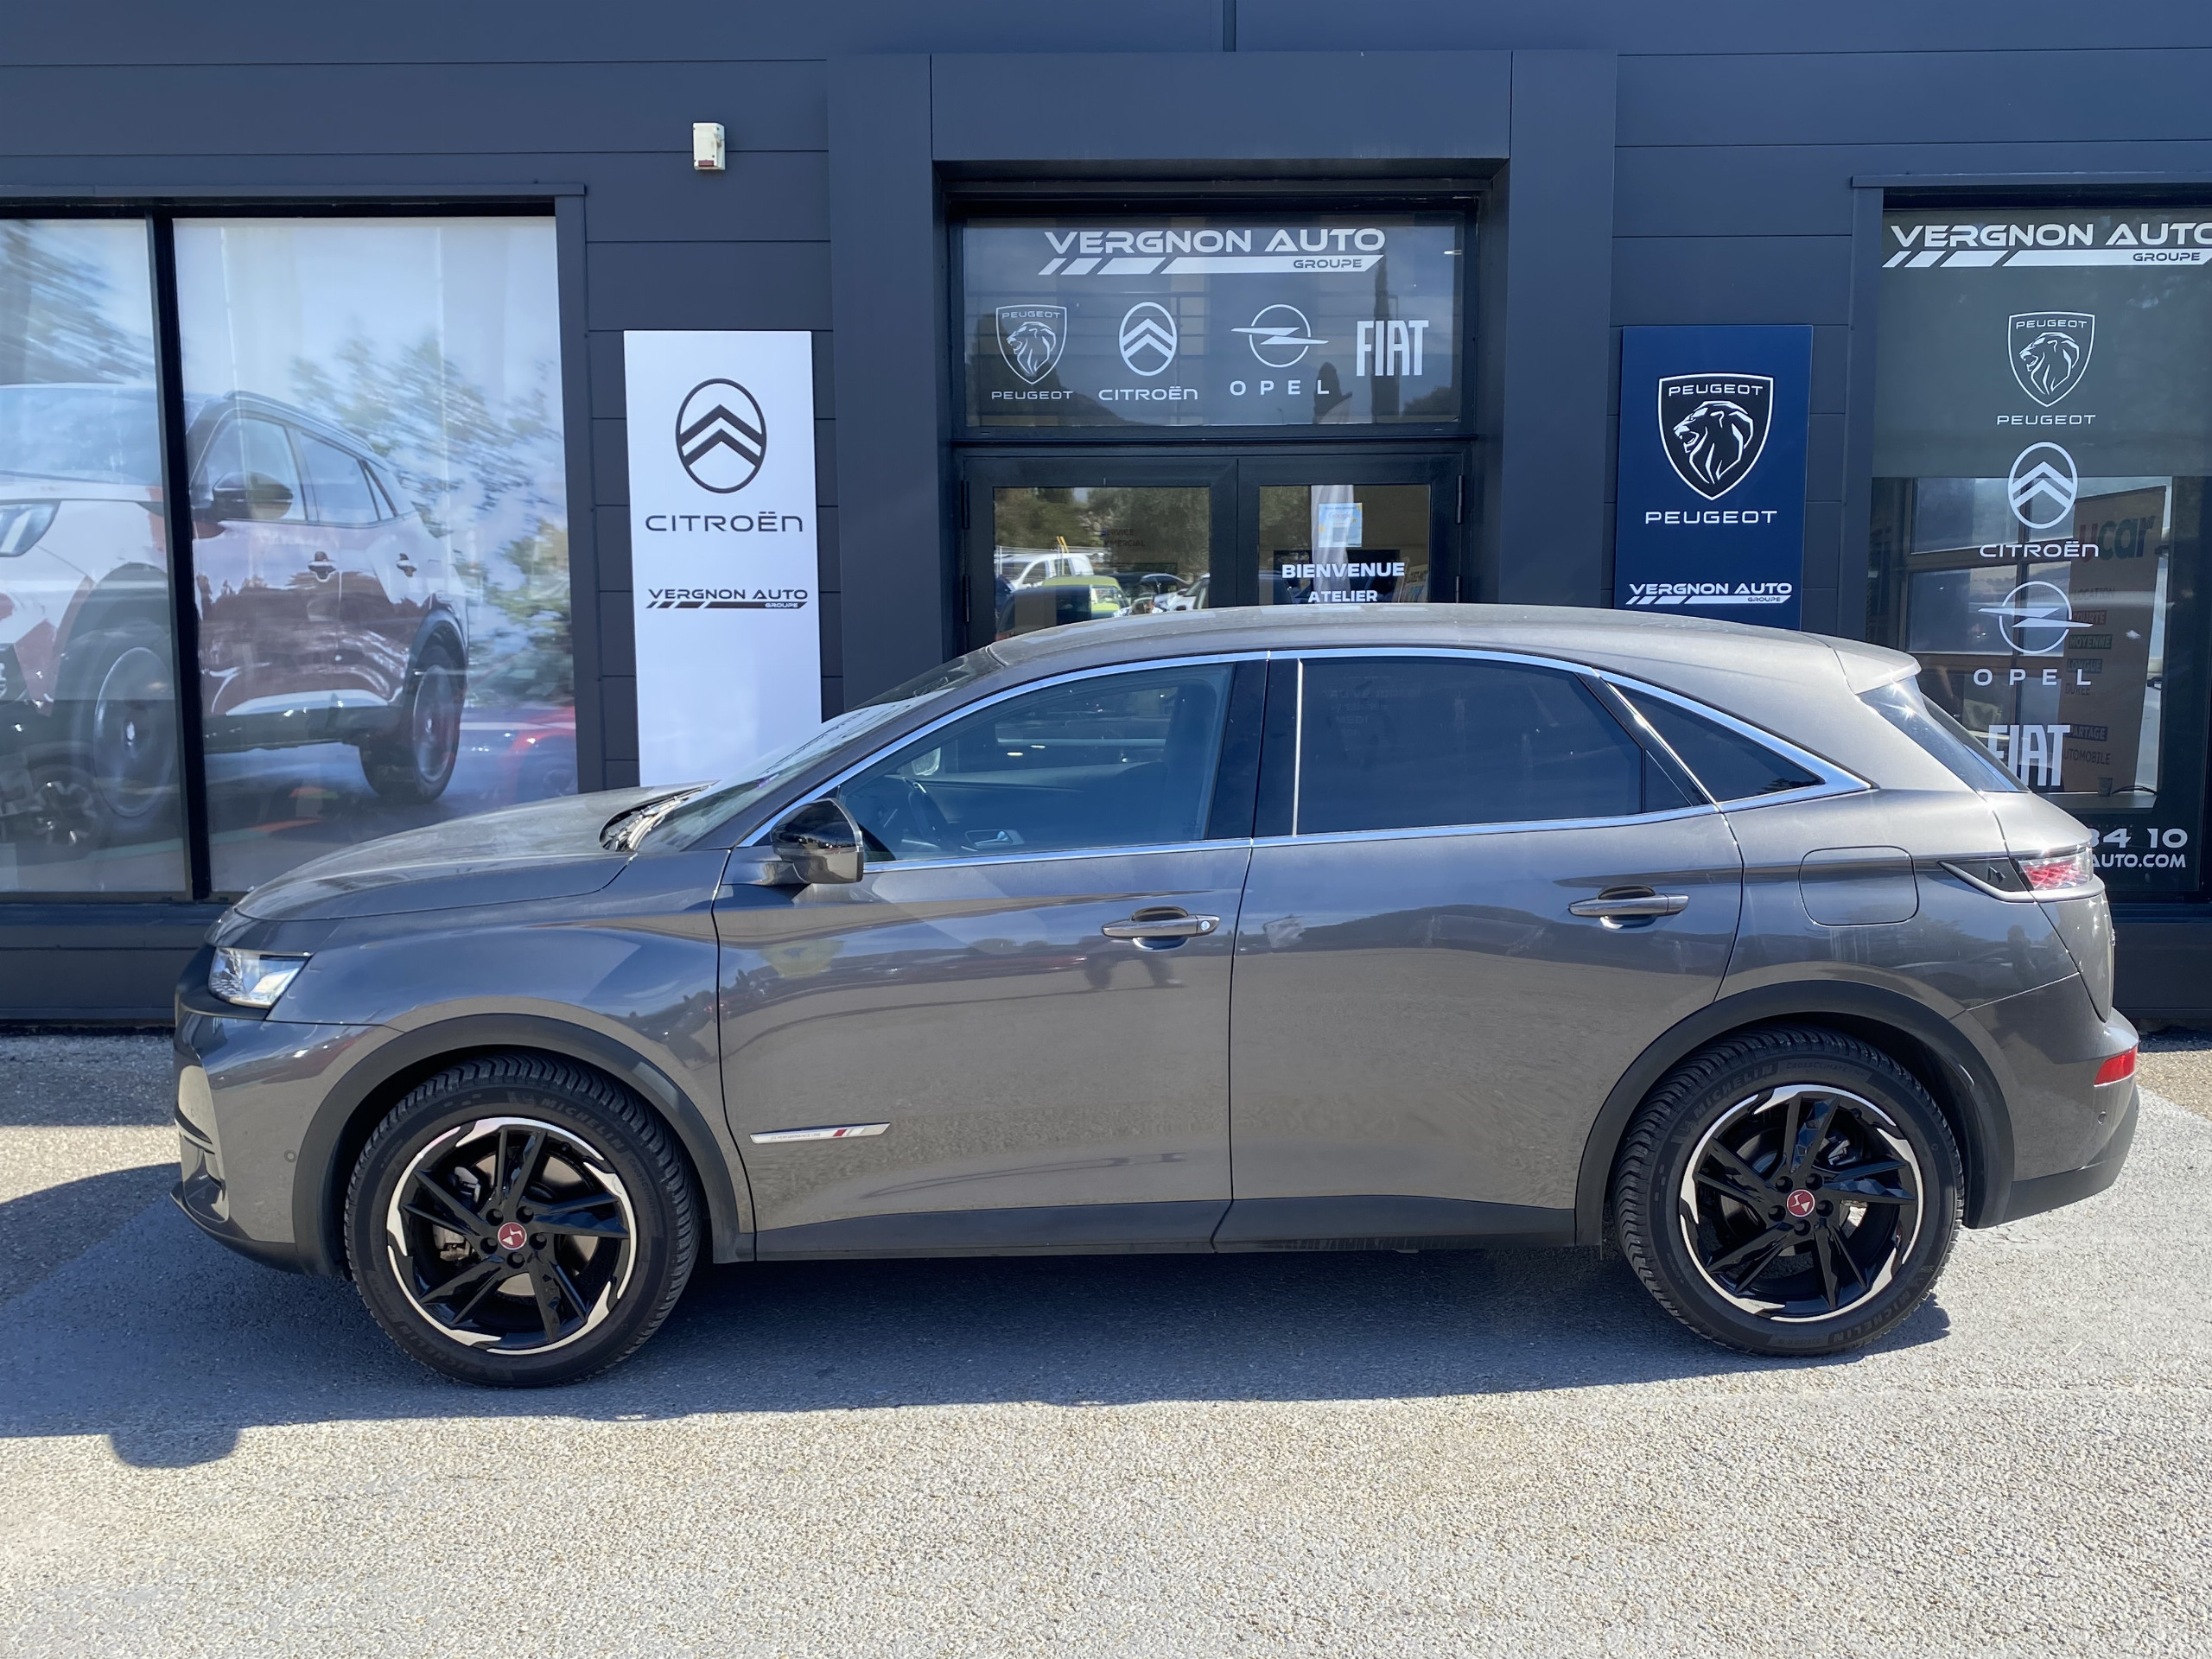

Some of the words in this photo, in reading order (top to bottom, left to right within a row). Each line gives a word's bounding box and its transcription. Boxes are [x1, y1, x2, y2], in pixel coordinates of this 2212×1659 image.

[1044, 230, 1252, 255] VERGNON
[1264, 228, 1386, 252] AUTO
[1890, 223, 2094, 248] VERGNON
[1293, 257, 1363, 270] GROUPE
[2133, 251, 2201, 262] GROUPE
[1001, 309, 1061, 320] PEUGEOT
[2016, 319, 2088, 329] PEUGEOT
[1357, 320, 1429, 376] FIAT
[1097, 385, 1198, 401] CITROËN
[1230, 379, 1330, 396] OPEL
[1669, 384, 1763, 396] PEUGEOT
[991, 391, 1074, 401] PEUGEOT
[1997, 415, 2096, 426] PEUGEOT
[645, 512, 804, 532] CITROËN
[1645, 511, 1777, 524] PEUGEOT
[1980, 541, 2099, 557] CITROËN
[1281, 563, 1405, 578] BIENVENUE
[649, 589, 746, 600] VERGNON
[752, 589, 808, 600] AUTO
[1307, 590, 1377, 603] ATELIER
[1630, 584, 1729, 595] VERGNON
[1734, 583, 1793, 594] AUTO
[1973, 668, 2092, 686] OPEL
[2063, 748, 2111, 765] UTOMOBILE
[2146, 828, 2188, 849] 10
[1694, 1064, 1773, 1117] MICHELIN
[542, 1097, 628, 1152] MICHELIN
